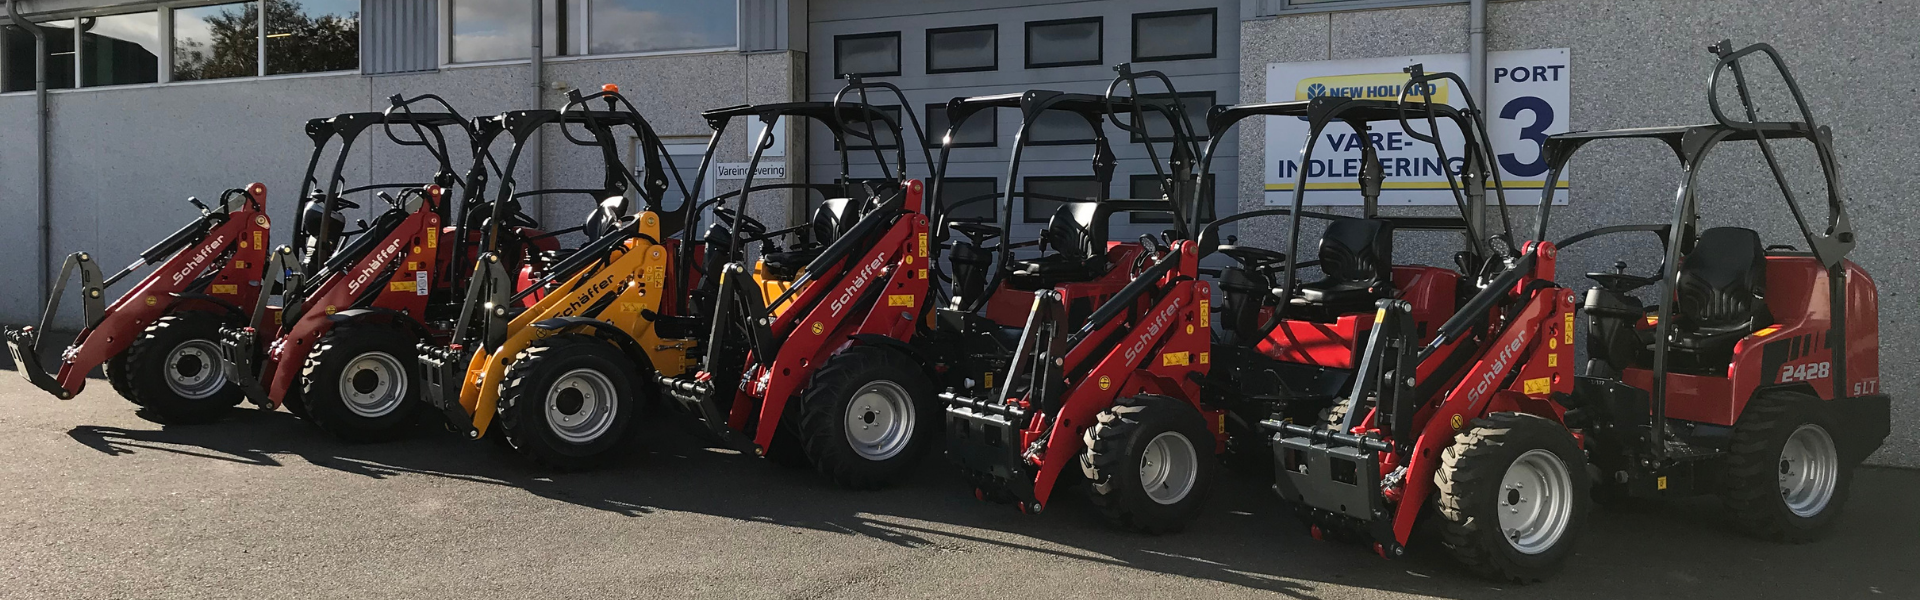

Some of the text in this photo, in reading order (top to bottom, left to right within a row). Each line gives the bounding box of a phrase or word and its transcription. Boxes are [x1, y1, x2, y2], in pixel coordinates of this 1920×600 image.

[1494, 65, 1565, 83] PORT
[1329, 86, 1364, 99] NEW
[1325, 131, 1413, 152] VARE-
[1497, 95, 1555, 177] 3
[1278, 156, 1465, 178] INDLEERING
[172, 235, 224, 286] Schäffer
[347, 238, 401, 296] Schäffer
[830, 251, 885, 318] Schäffer
[1124, 297, 1181, 368] Schäffer
[1467, 329, 1526, 411] Schäffer
[1781, 361, 1831, 383] 2428
[1853, 380, 1877, 396] SLT
